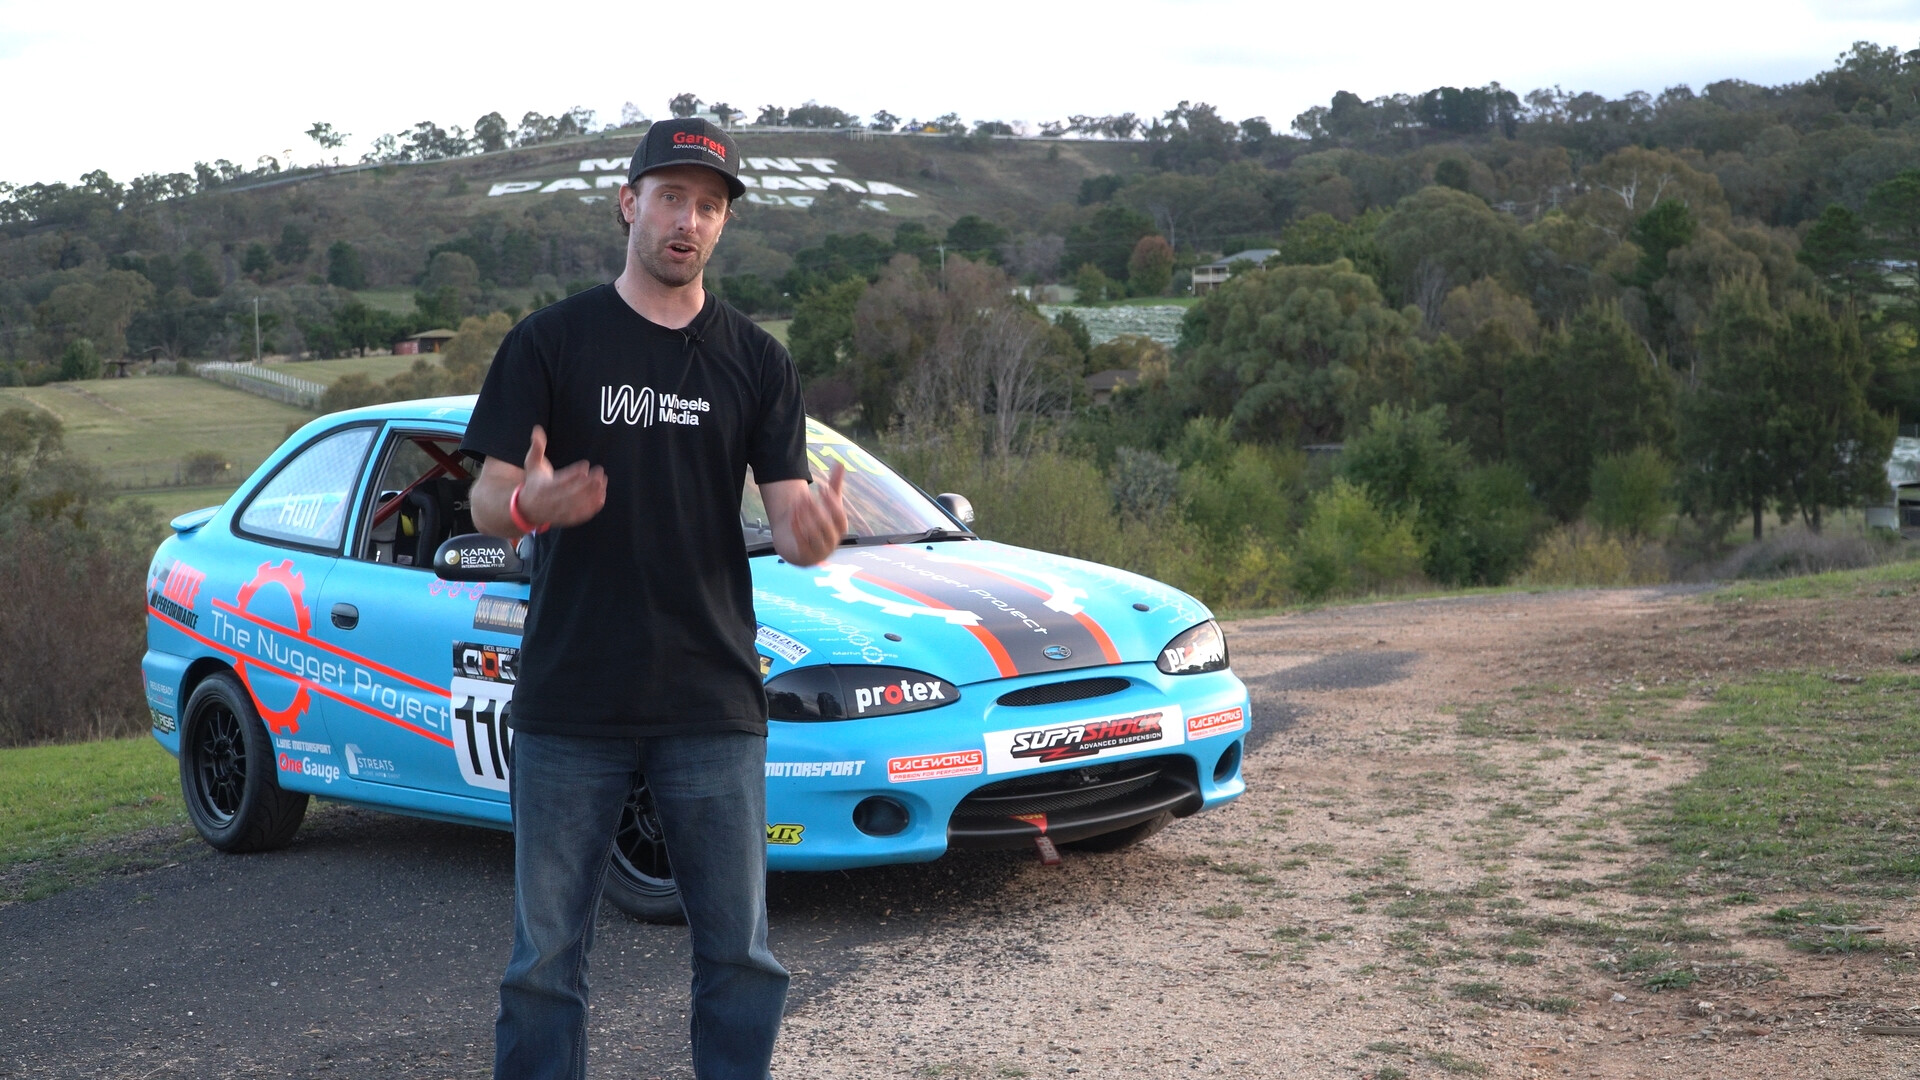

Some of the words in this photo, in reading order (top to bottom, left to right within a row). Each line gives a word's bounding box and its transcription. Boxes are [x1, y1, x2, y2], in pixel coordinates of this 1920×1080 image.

[673, 131, 726, 158] Garrett
[708, 149, 725, 162] MOTION
[659, 393, 711, 412] Wheels
[659, 407, 700, 425] Media
[278, 493, 323, 529] Hull
[460, 548, 505, 556] KARMA
[461, 556, 505, 564] REALTY
[893, 562, 970, 589] Nugget
[211, 610, 250, 648] The
[258, 629, 346, 687] Nugget
[353, 668, 449, 731] Project
[855, 680, 945, 713] protex
[1190, 710, 1241, 729] RACEWORKS
[292, 740, 331, 755] MOTORSPORT
[1079, 739, 1117, 750] ADVANCED
[1119, 732, 1162, 744] SUSPENSION
[279, 752, 340, 784] OneGauge
[357, 758, 394, 771] STREATS
[765, 761, 866, 777] MOTORSPORT
[892, 753, 980, 771] RACEWORKS
[893, 772, 921, 780] PASSION
[936, 766, 980, 775] PERFORMANCE
